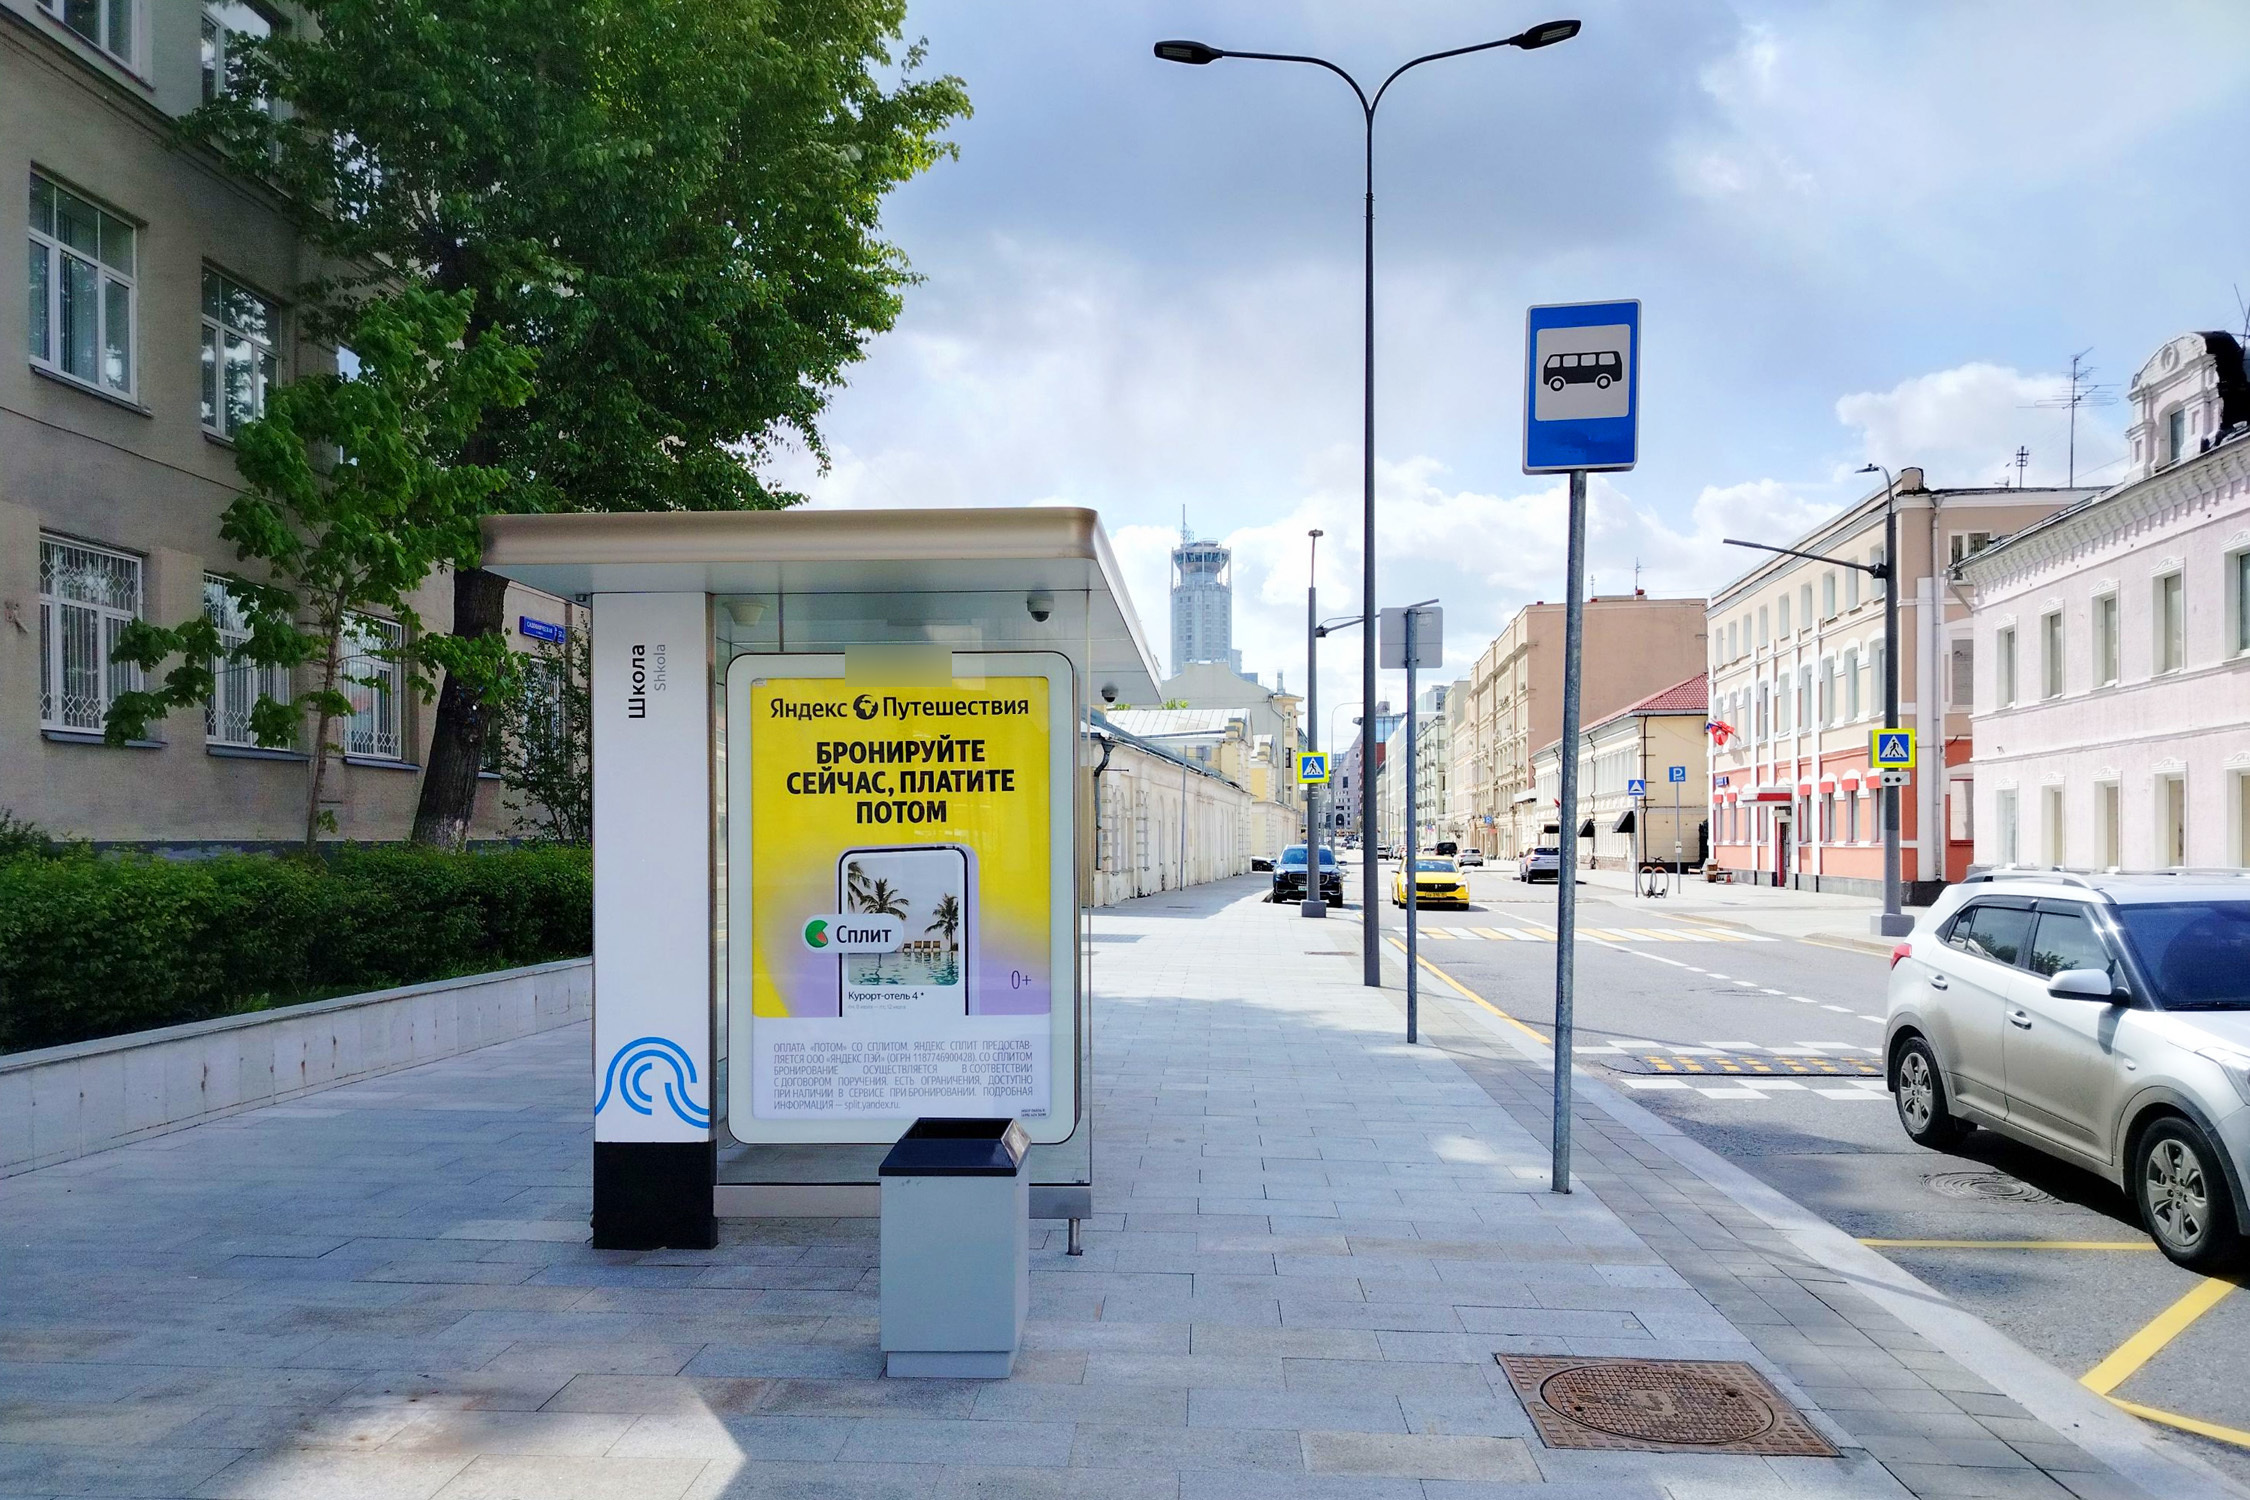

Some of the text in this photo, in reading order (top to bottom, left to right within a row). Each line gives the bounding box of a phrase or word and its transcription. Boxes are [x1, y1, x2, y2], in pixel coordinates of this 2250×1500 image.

[653, 644, 666, 691] Shkola
[628, 644, 646, 719] Школа
[770, 695, 1029, 721] Яндекс Путешествия
[815, 734, 986, 765] БРОНИРУЙТЕ
[786, 766, 1015, 797] СЕЙЧАС, ПЛАТИТЕ
[856, 800, 948, 824] ПОТОМ
[836, 925, 892, 944] Сплит
[1011, 970, 1032, 990] 0+
[848, 991, 911, 1002] Курорт-отель
[774, 1043, 805, 1053] ОПЛАТА
[810, 1042, 847, 1052] «ПОТОМ»
[851, 1042, 863, 1052] СО
[914, 1041, 945, 1052] ЯНДЕКС
[950, 1041, 978, 1051] СПЛИТ
[982, 1040, 1033, 1051] ПРЕДОСТАВ-
[774, 1054, 805, 1064] ЛЯЕТСЯ
[806, 1054, 825, 1063] ООО
[826, 1054, 862, 1064] «ЯНДЕКС
[864, 1052, 885, 1063] ПЭЙ»
[887, 1053, 911, 1064] (ОГРН
[979, 1053, 990, 1062] СО
[992, 1052, 1033, 1062] СПЛИТОМ
[774, 1063, 1033, 1075] БРОНИРОВАНИЕ ОСУЩЕСТВЛЯЕТСЯ В СООТВЕТСТВИИ
[774, 1077, 780, 1087] С
[780, 1077, 832, 1088] ДОГОВОРОМ
[838, 1076, 889, 1086] ПОРУЧЕНИЯ.
[894, 1076, 915, 1086] ЕСТЬ
[988, 1075, 1033, 1086] ДОСТУПНО
[774, 1086, 1033, 1098] ПРИ НАЛИЧИИ В СЕРВИСЕ ПРИ БРОНИРОВАНИИ. ПОДРОБНАЯ
[774, 1100, 834, 1110] ИНФОРМАЦИЯ
